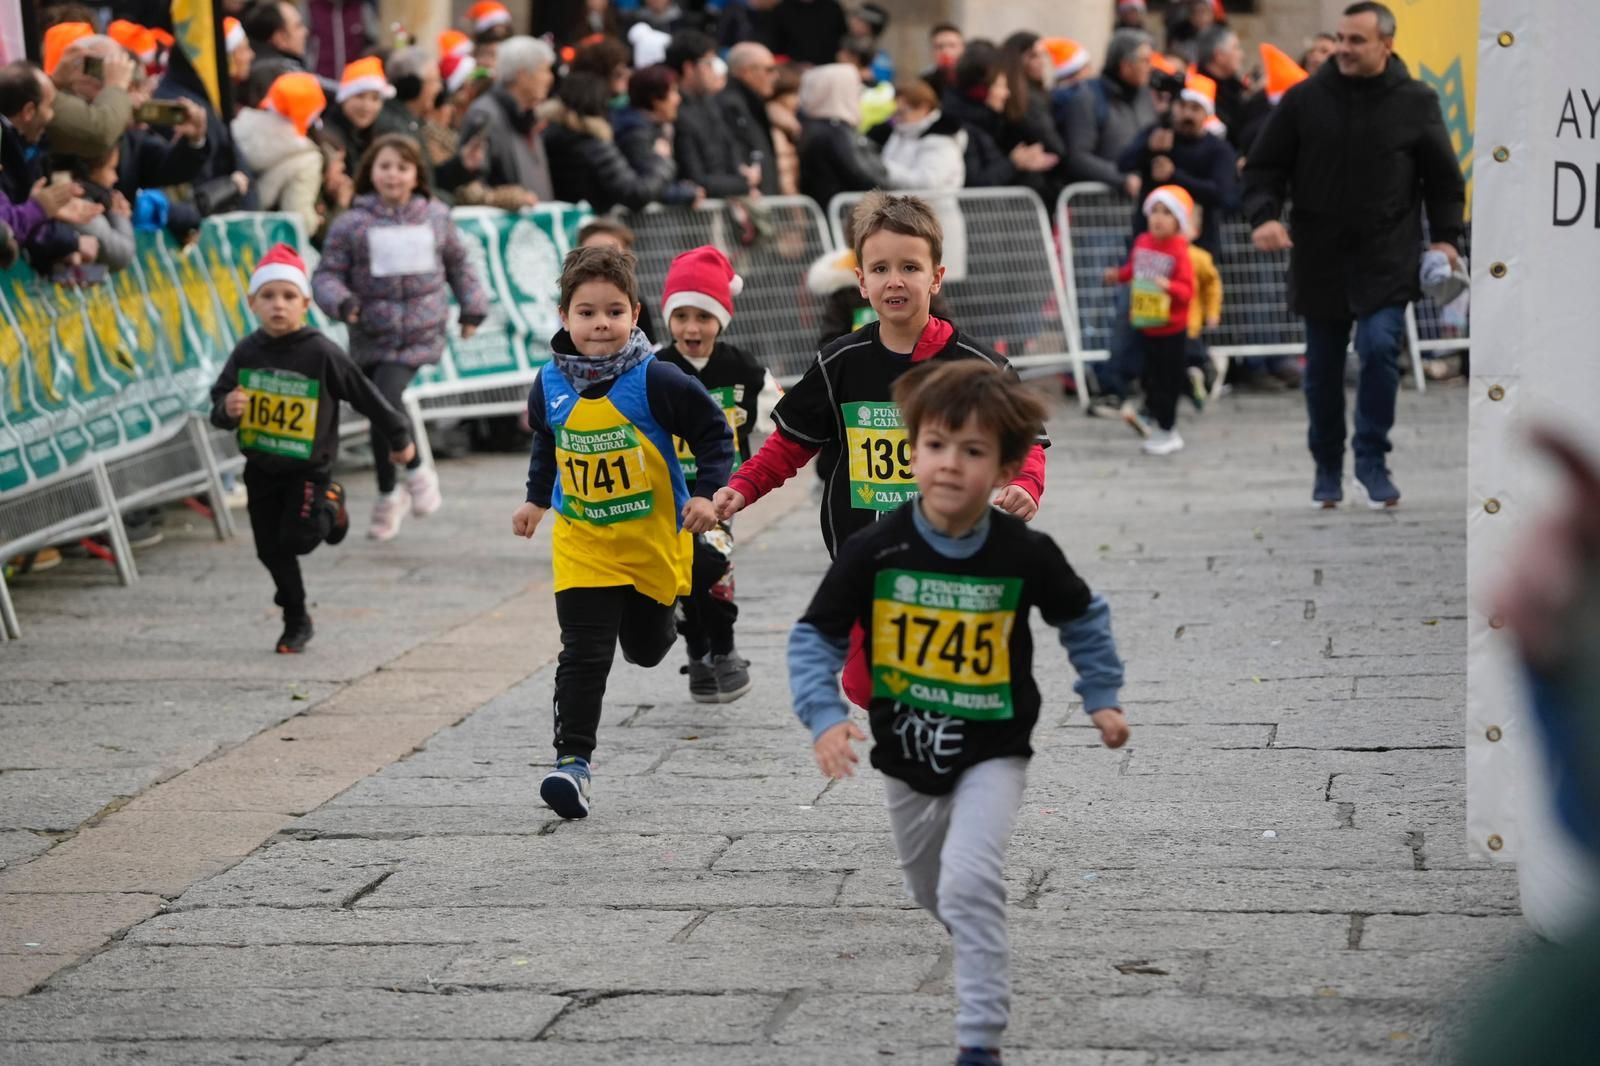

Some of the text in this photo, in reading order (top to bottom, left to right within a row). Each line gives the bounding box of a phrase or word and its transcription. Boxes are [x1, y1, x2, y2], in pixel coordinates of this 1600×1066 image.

[249, 394, 305, 431] 1642
[873, 418, 898, 427] CAJA
[569, 429, 627, 445] FUNDACION
[571, 439, 629, 453] CAJA RURAL
[565, 456, 631, 496] 1741
[875, 491, 903, 503] CAJA
[585, 500, 651, 519] CAJA RURAL
[890, 613, 995, 676] 1745
[910, 684, 949, 703] CAJA
